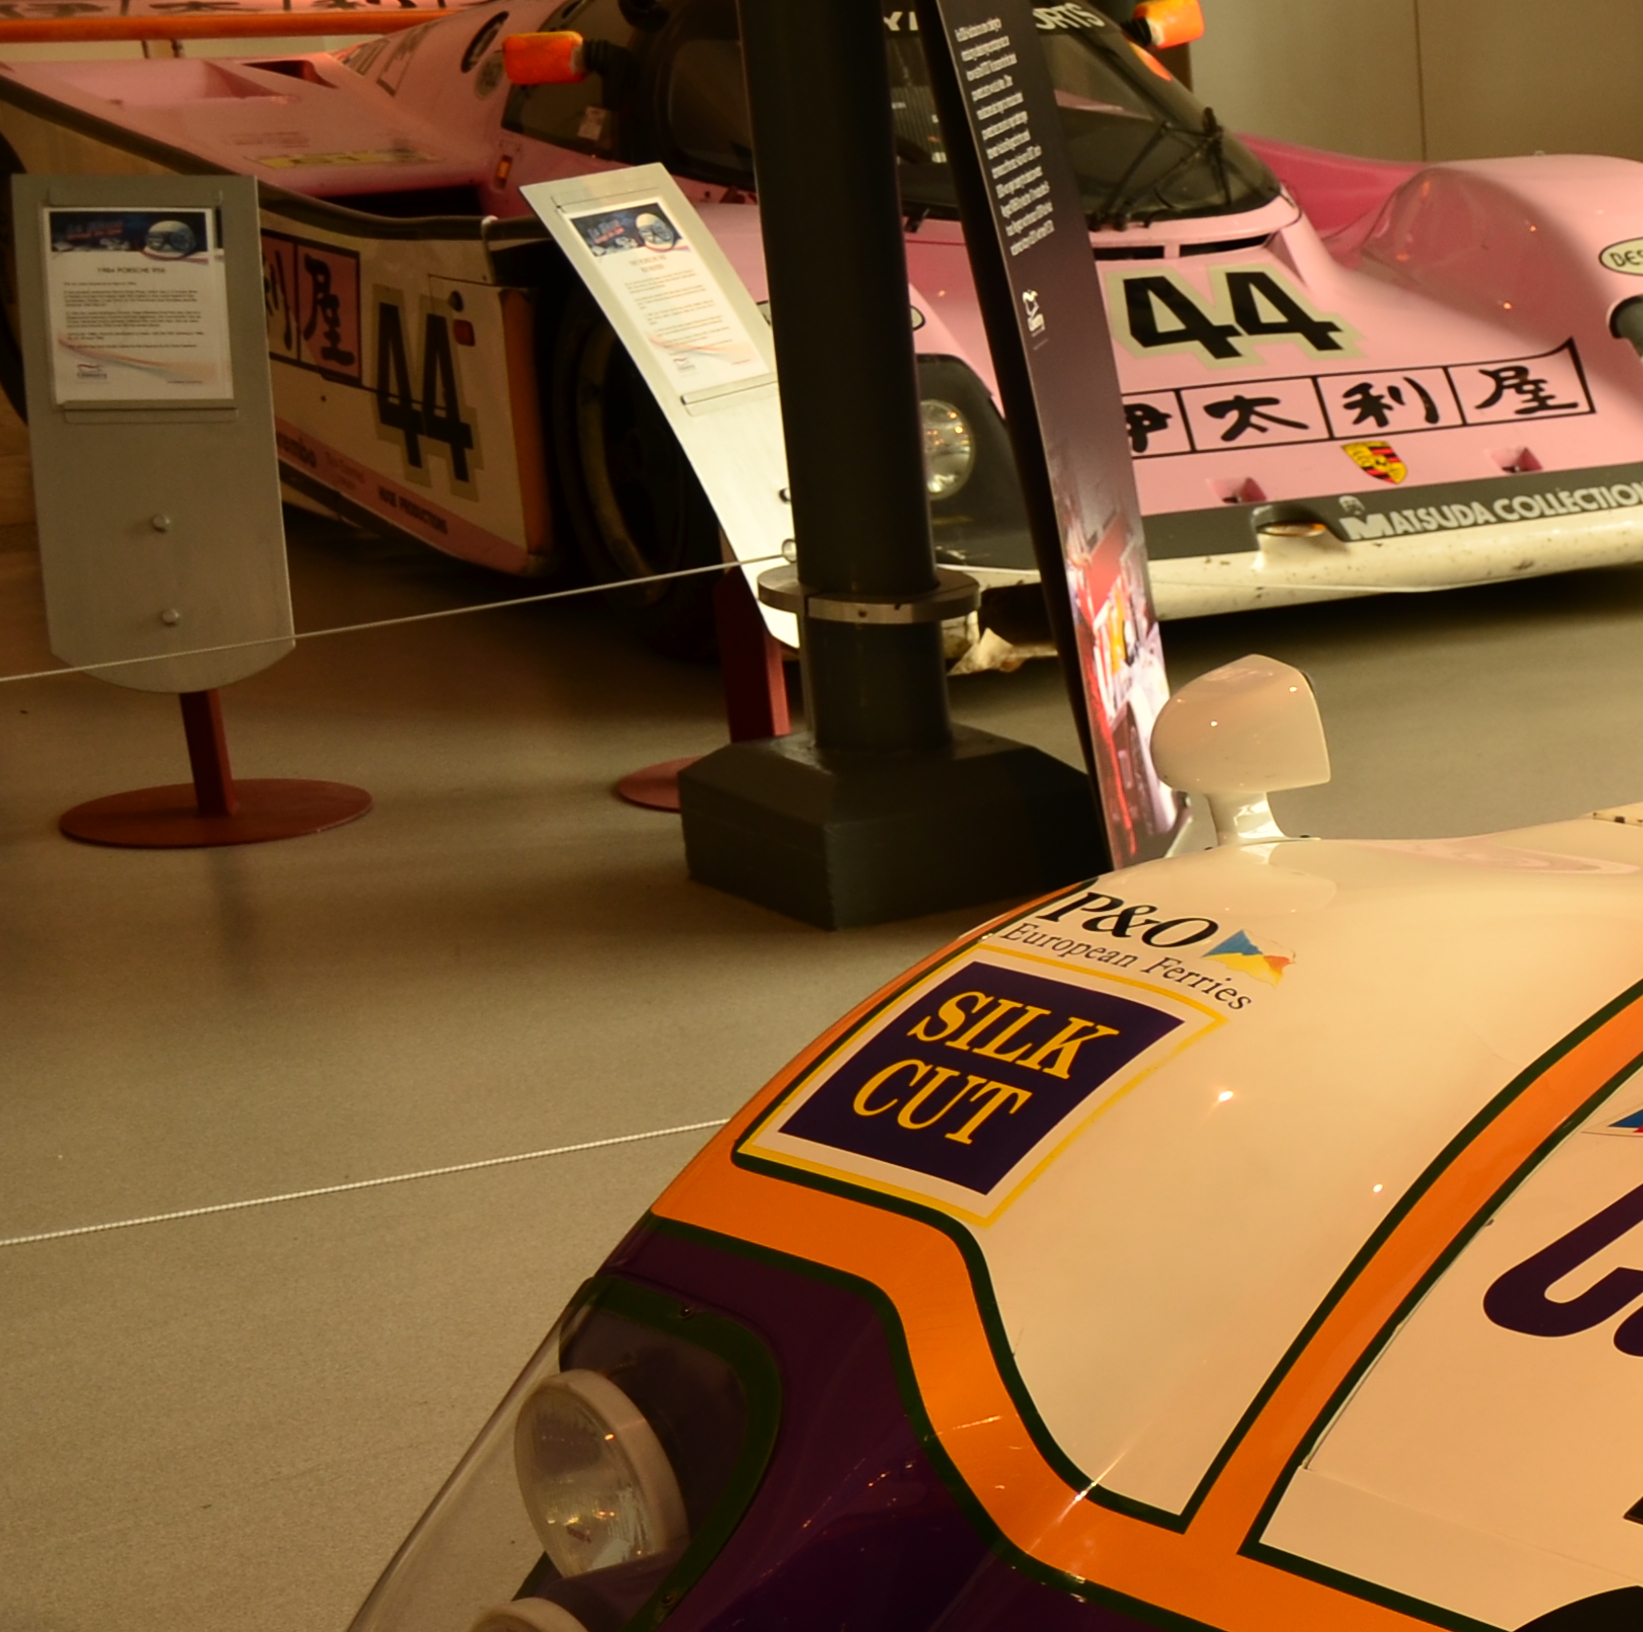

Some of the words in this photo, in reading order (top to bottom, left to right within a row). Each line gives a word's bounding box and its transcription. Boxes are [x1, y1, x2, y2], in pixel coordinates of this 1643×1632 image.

[1123, 271, 1343, 359] 44
[377, 301, 474, 483] 44
[1339, 501, 1497, 540] MATSUDA
[1036, 892, 1219, 948] P&O
[1000, 922, 1139, 968] European
[1141, 957, 1252, 1011] Ferries
[907, 990, 1119, 1080] SILK
[852, 1058, 1032, 1146] CUT
